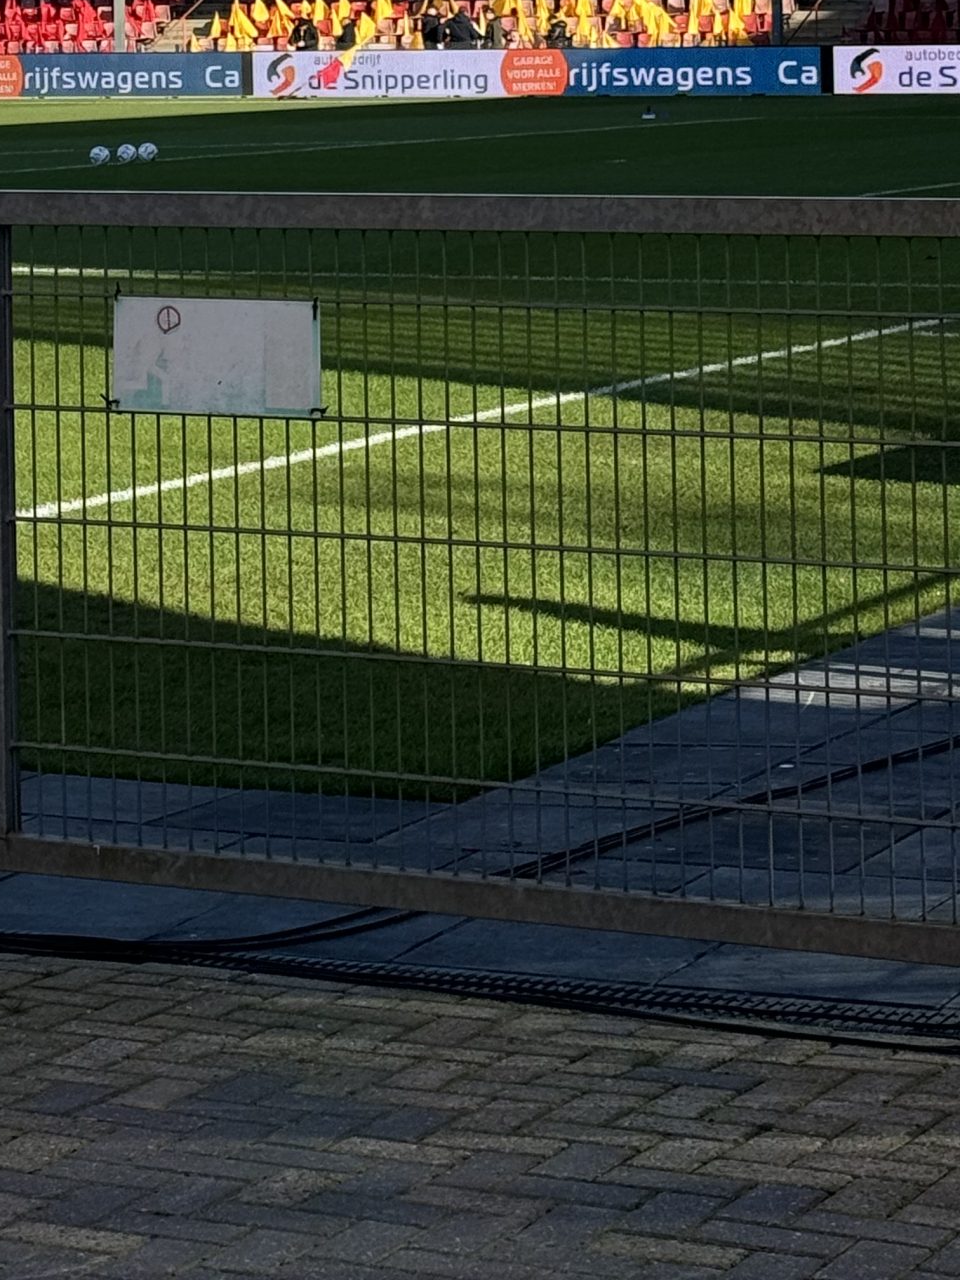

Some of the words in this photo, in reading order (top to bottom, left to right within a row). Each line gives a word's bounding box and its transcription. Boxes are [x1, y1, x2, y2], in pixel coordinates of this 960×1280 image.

[24, 67, 183, 94] rijfswagens
[205, 65, 240, 88] Ca
[344, 68, 488, 94] Snipperling
[537, 67, 561, 78] ALLE
[568, 62, 752, 91] rijfswagens
[778, 60, 818, 85] Ca
[898, 65, 932, 88] de
